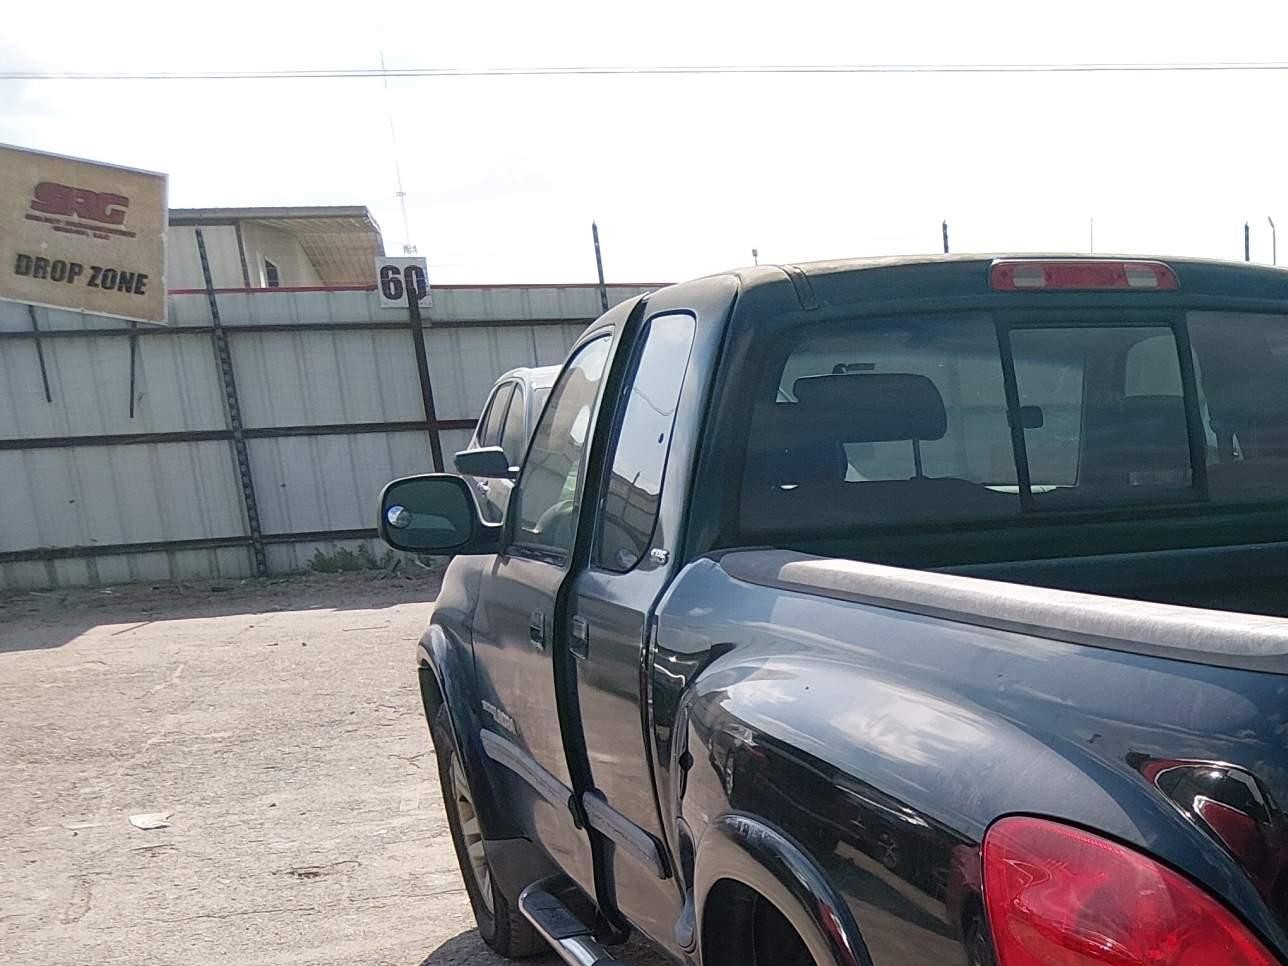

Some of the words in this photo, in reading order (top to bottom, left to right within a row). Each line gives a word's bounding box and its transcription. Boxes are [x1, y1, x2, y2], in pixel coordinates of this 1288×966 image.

[31, 182, 130, 225] SRG
[15, 253, 84, 284] DROP
[86, 265, 149, 295] ZONE
[380, 265, 427, 300] 60
